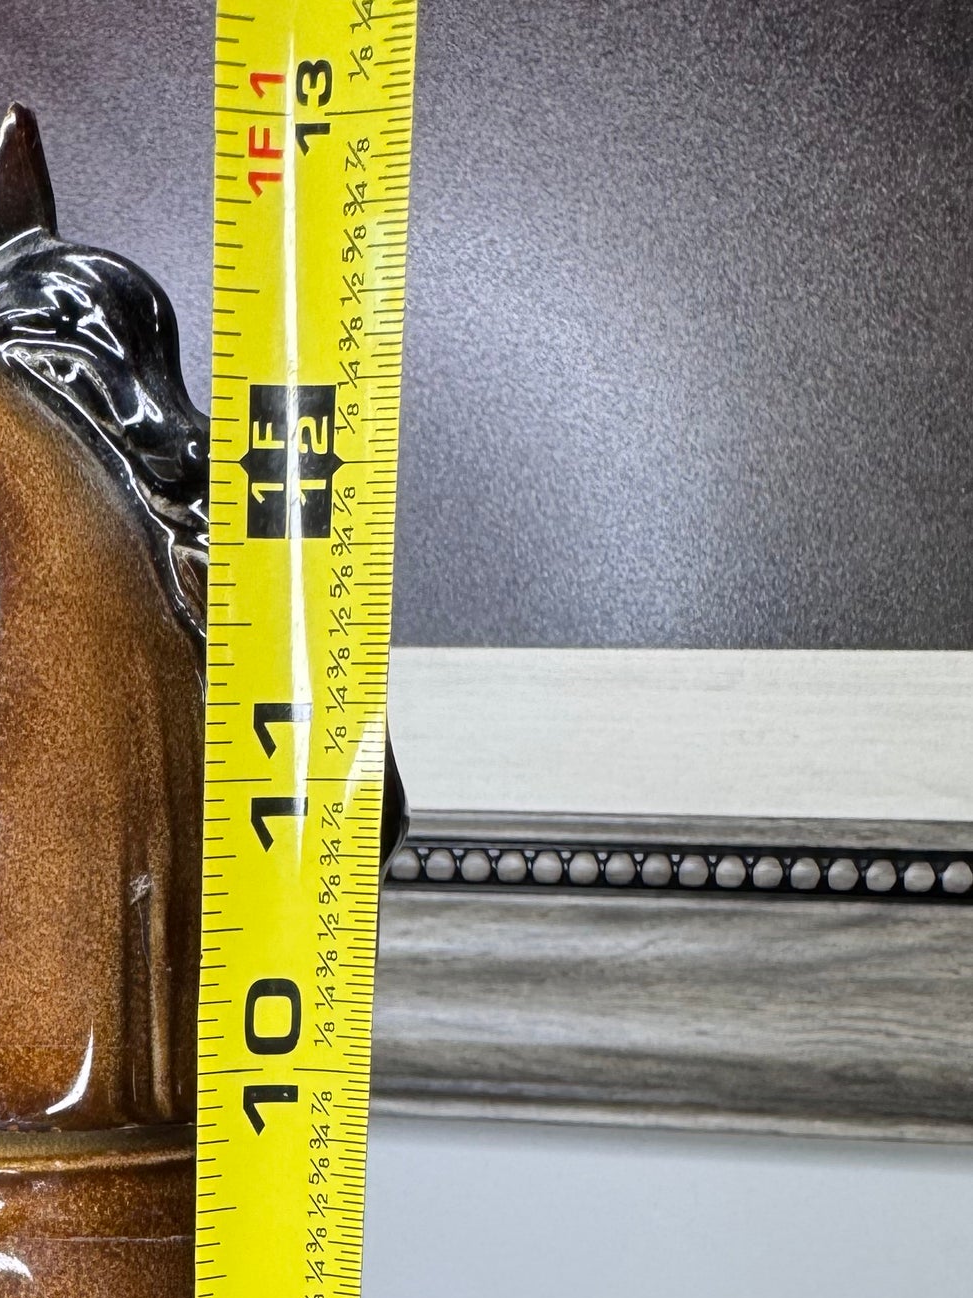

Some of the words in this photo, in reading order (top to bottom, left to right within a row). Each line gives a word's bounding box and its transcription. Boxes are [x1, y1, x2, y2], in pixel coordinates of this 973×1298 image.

[249, 72, 285, 99] 1
[295, 59, 332, 156] 13
[299, 415, 328, 506] 12
[251, 703, 311, 853] 11
[243, 978, 301, 1136] 10
